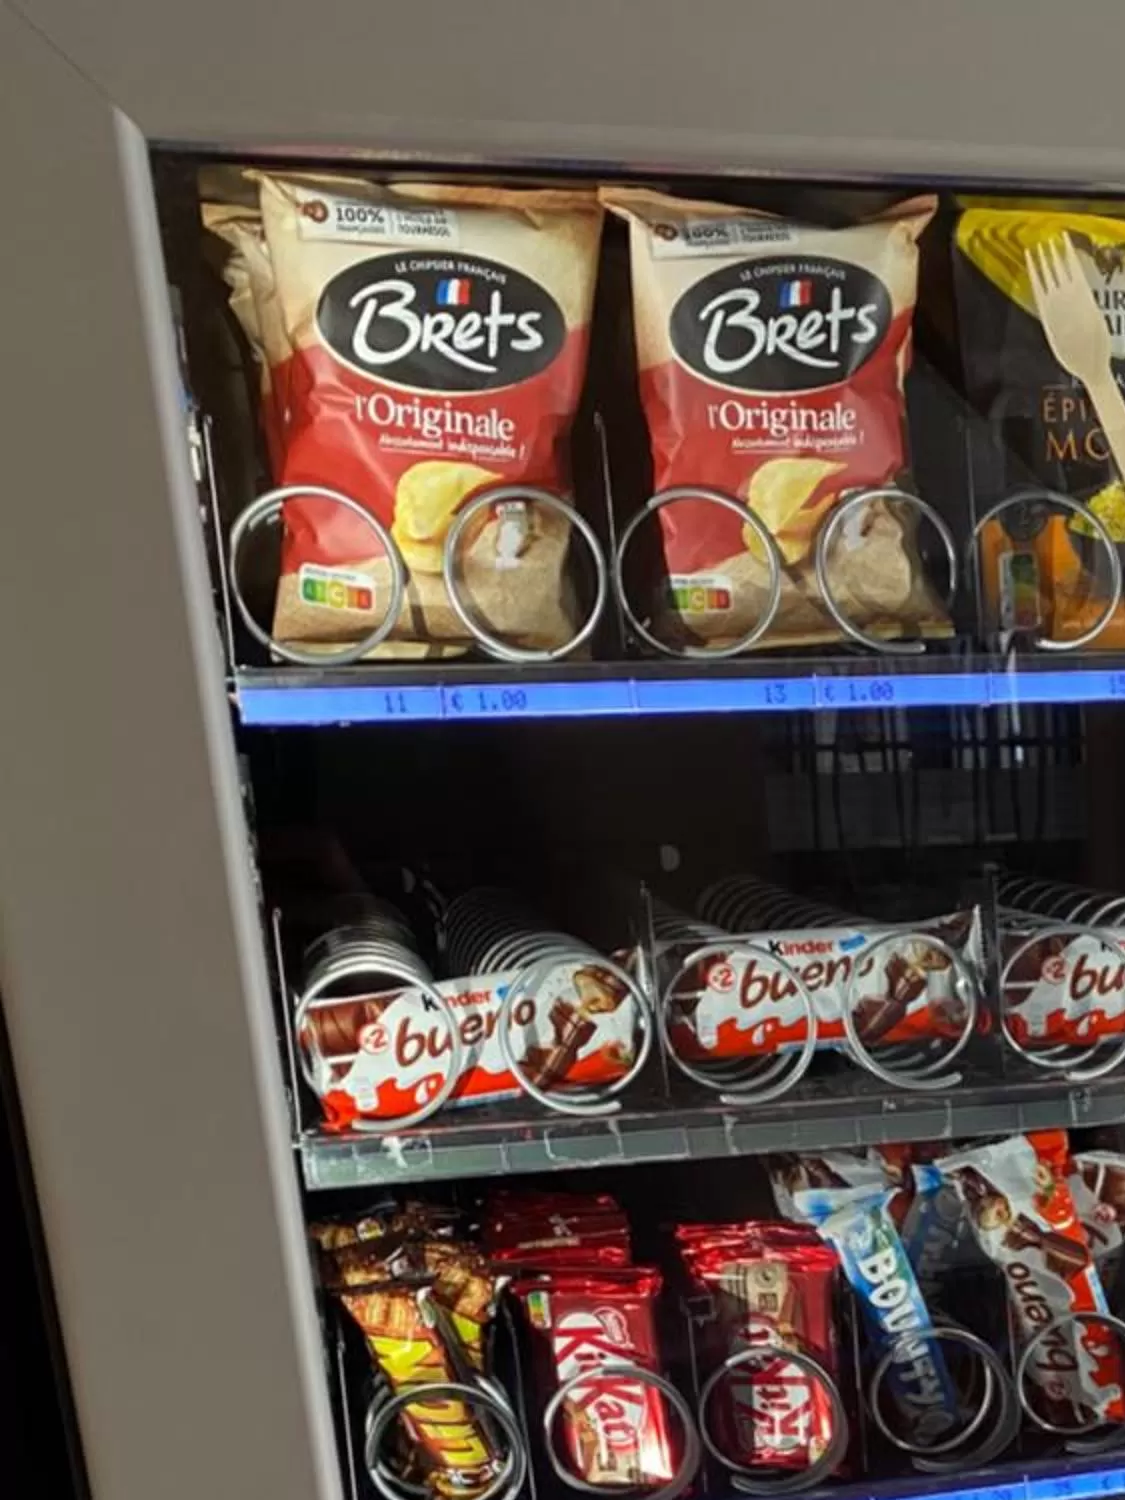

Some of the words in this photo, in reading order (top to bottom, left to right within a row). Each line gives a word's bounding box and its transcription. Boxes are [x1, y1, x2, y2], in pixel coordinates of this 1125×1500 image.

[335, 206, 385, 225] 100%
[349, 278, 544, 374] Brets
[698, 286, 878, 374] Brets
[476, 689, 528, 712] 1.00
[847, 680, 896, 702] 1.00
[421, 990, 493, 1013] Knder
[394, 998, 537, 1069] bueno
[857, 1249, 944, 1409] BOUNTY
